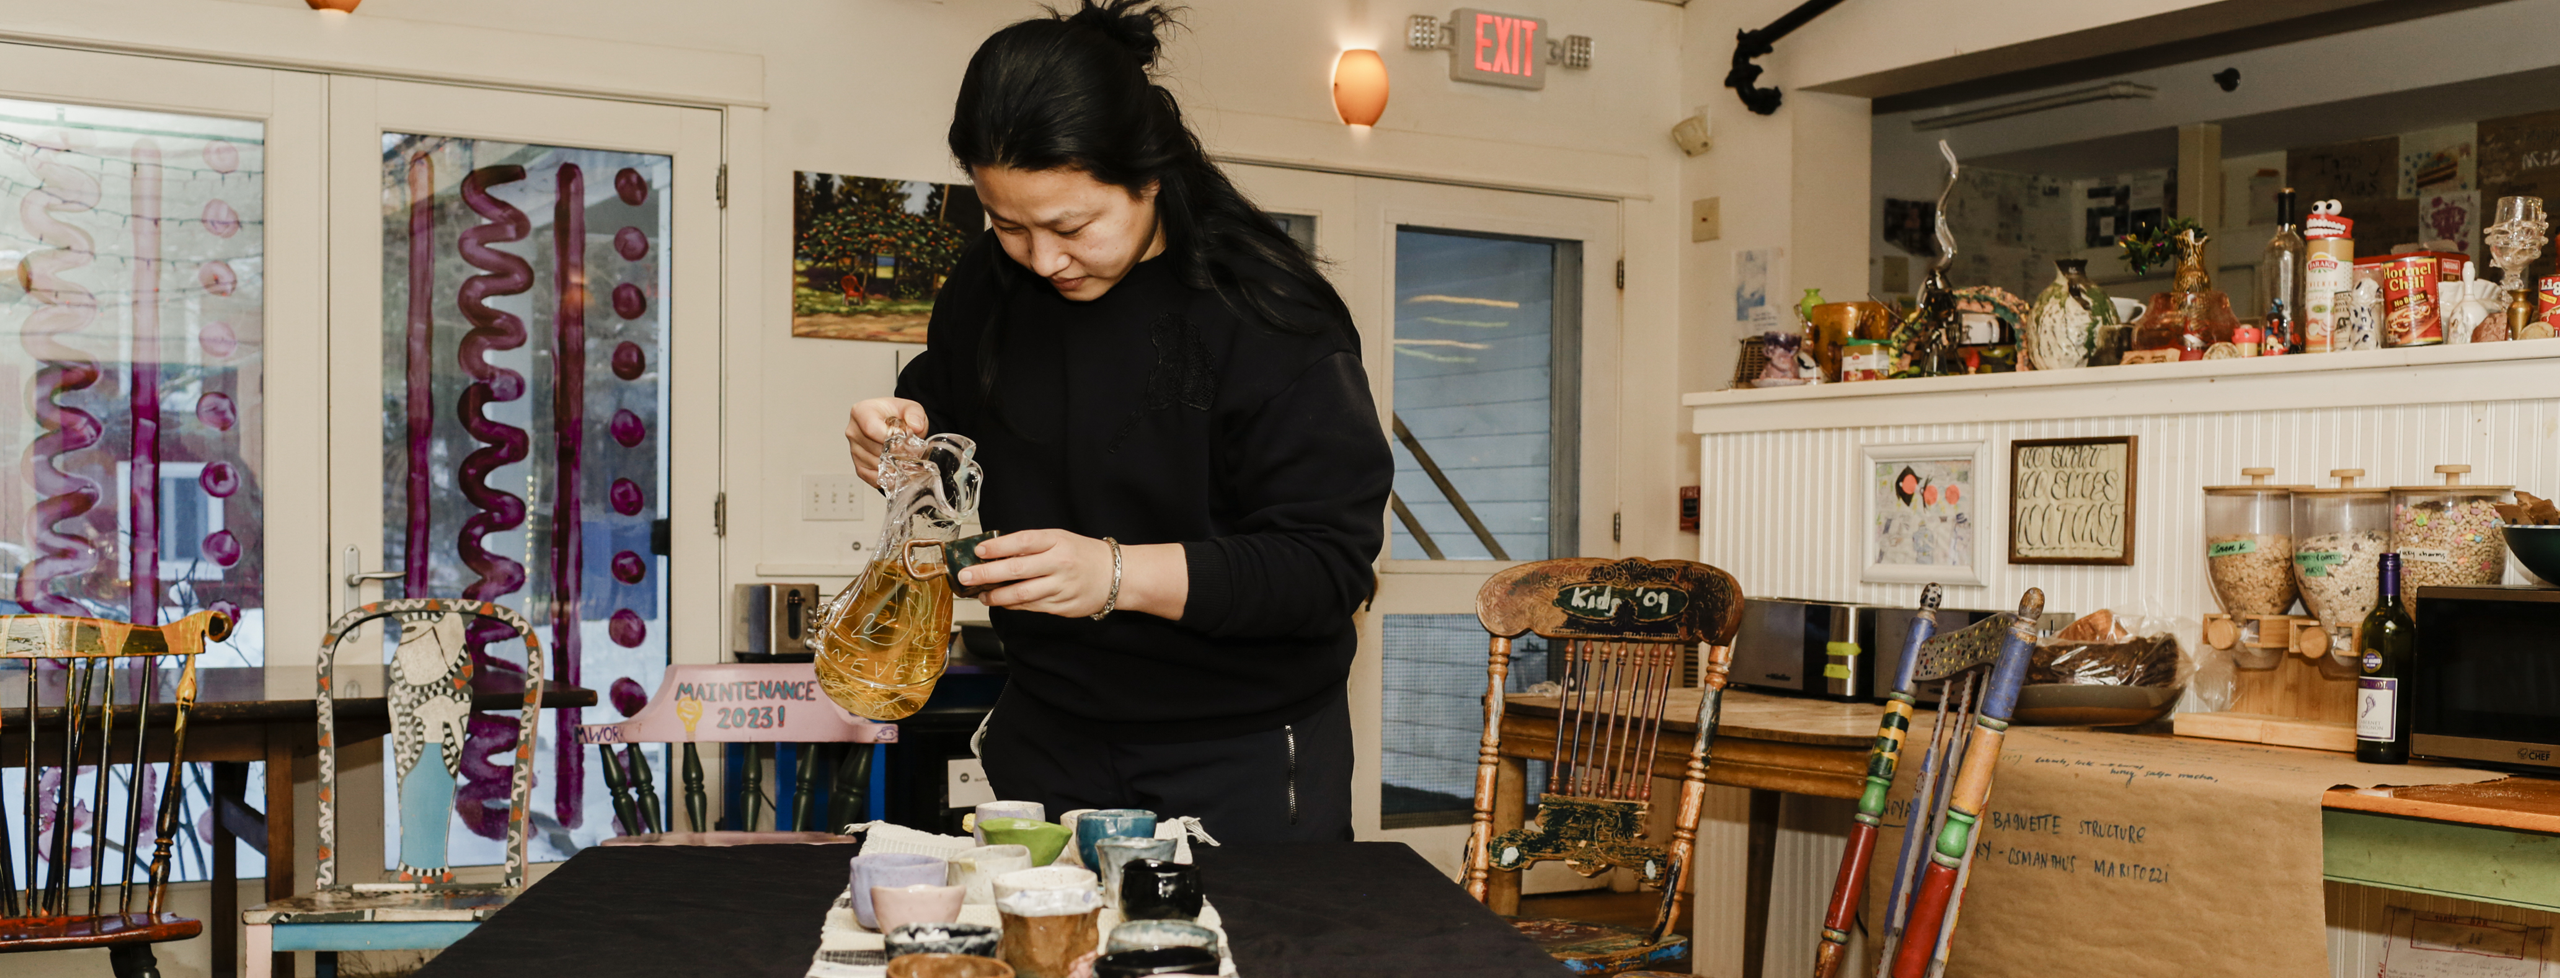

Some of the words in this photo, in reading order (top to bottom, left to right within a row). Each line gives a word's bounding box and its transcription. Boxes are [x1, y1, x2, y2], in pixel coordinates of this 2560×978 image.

[1475, 13, 1538, 77] EXIT
[2384, 263, 2431, 279] Hormel
[2389, 276, 2425, 291] Chili
[2051, 470, 2119, 501] SHOES
[1571, 586, 1622, 617] Kids
[1636, 586, 1669, 615] '09
[831, 648, 926, 681] NEVER
[675, 680, 817, 702] MAINTENANCE
[717, 705, 786, 729] 2023!
[2529, 752, 2550, 761] CHEF
[2008, 847, 2076, 873] OSMANTHUS
